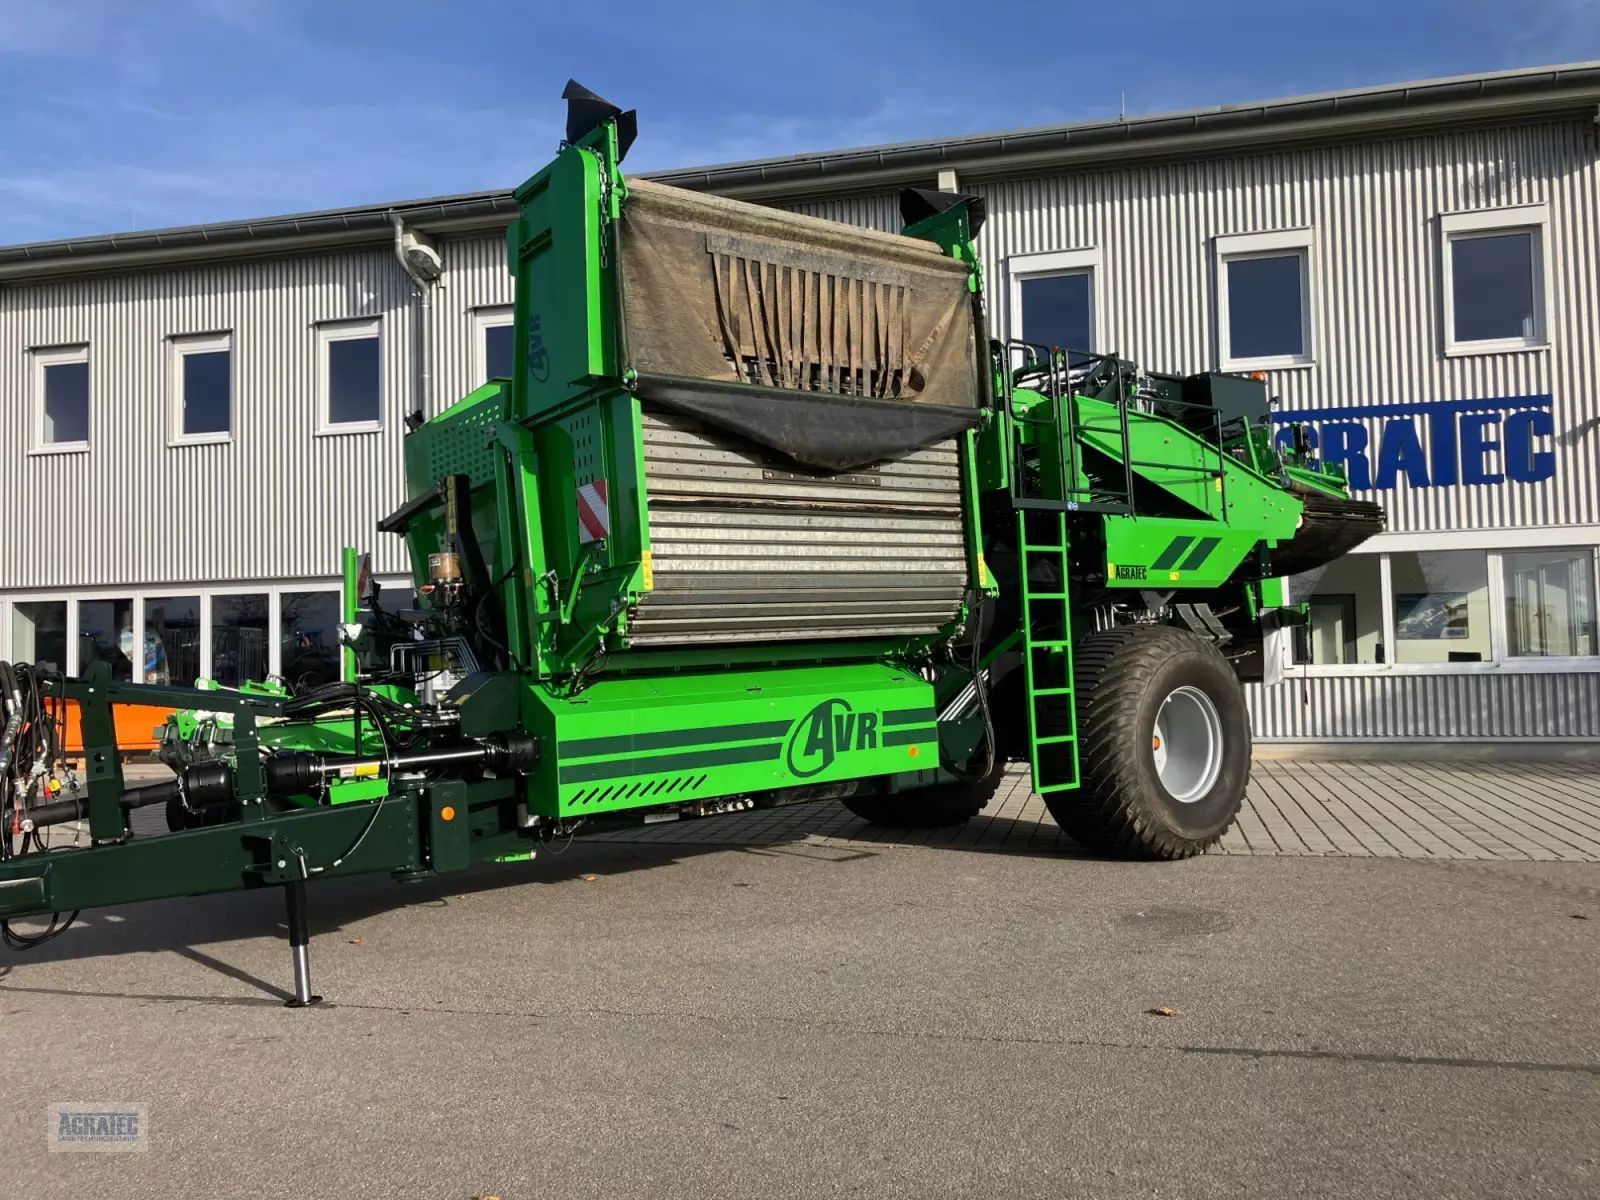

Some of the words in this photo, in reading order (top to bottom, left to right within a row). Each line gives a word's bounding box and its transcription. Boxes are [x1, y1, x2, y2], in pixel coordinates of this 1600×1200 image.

[529, 312, 550, 383] AVR
[1271, 394, 1554, 491] RATEC
[1115, 565, 1147, 580] AGRATEC
[787, 698, 878, 777] AVR
